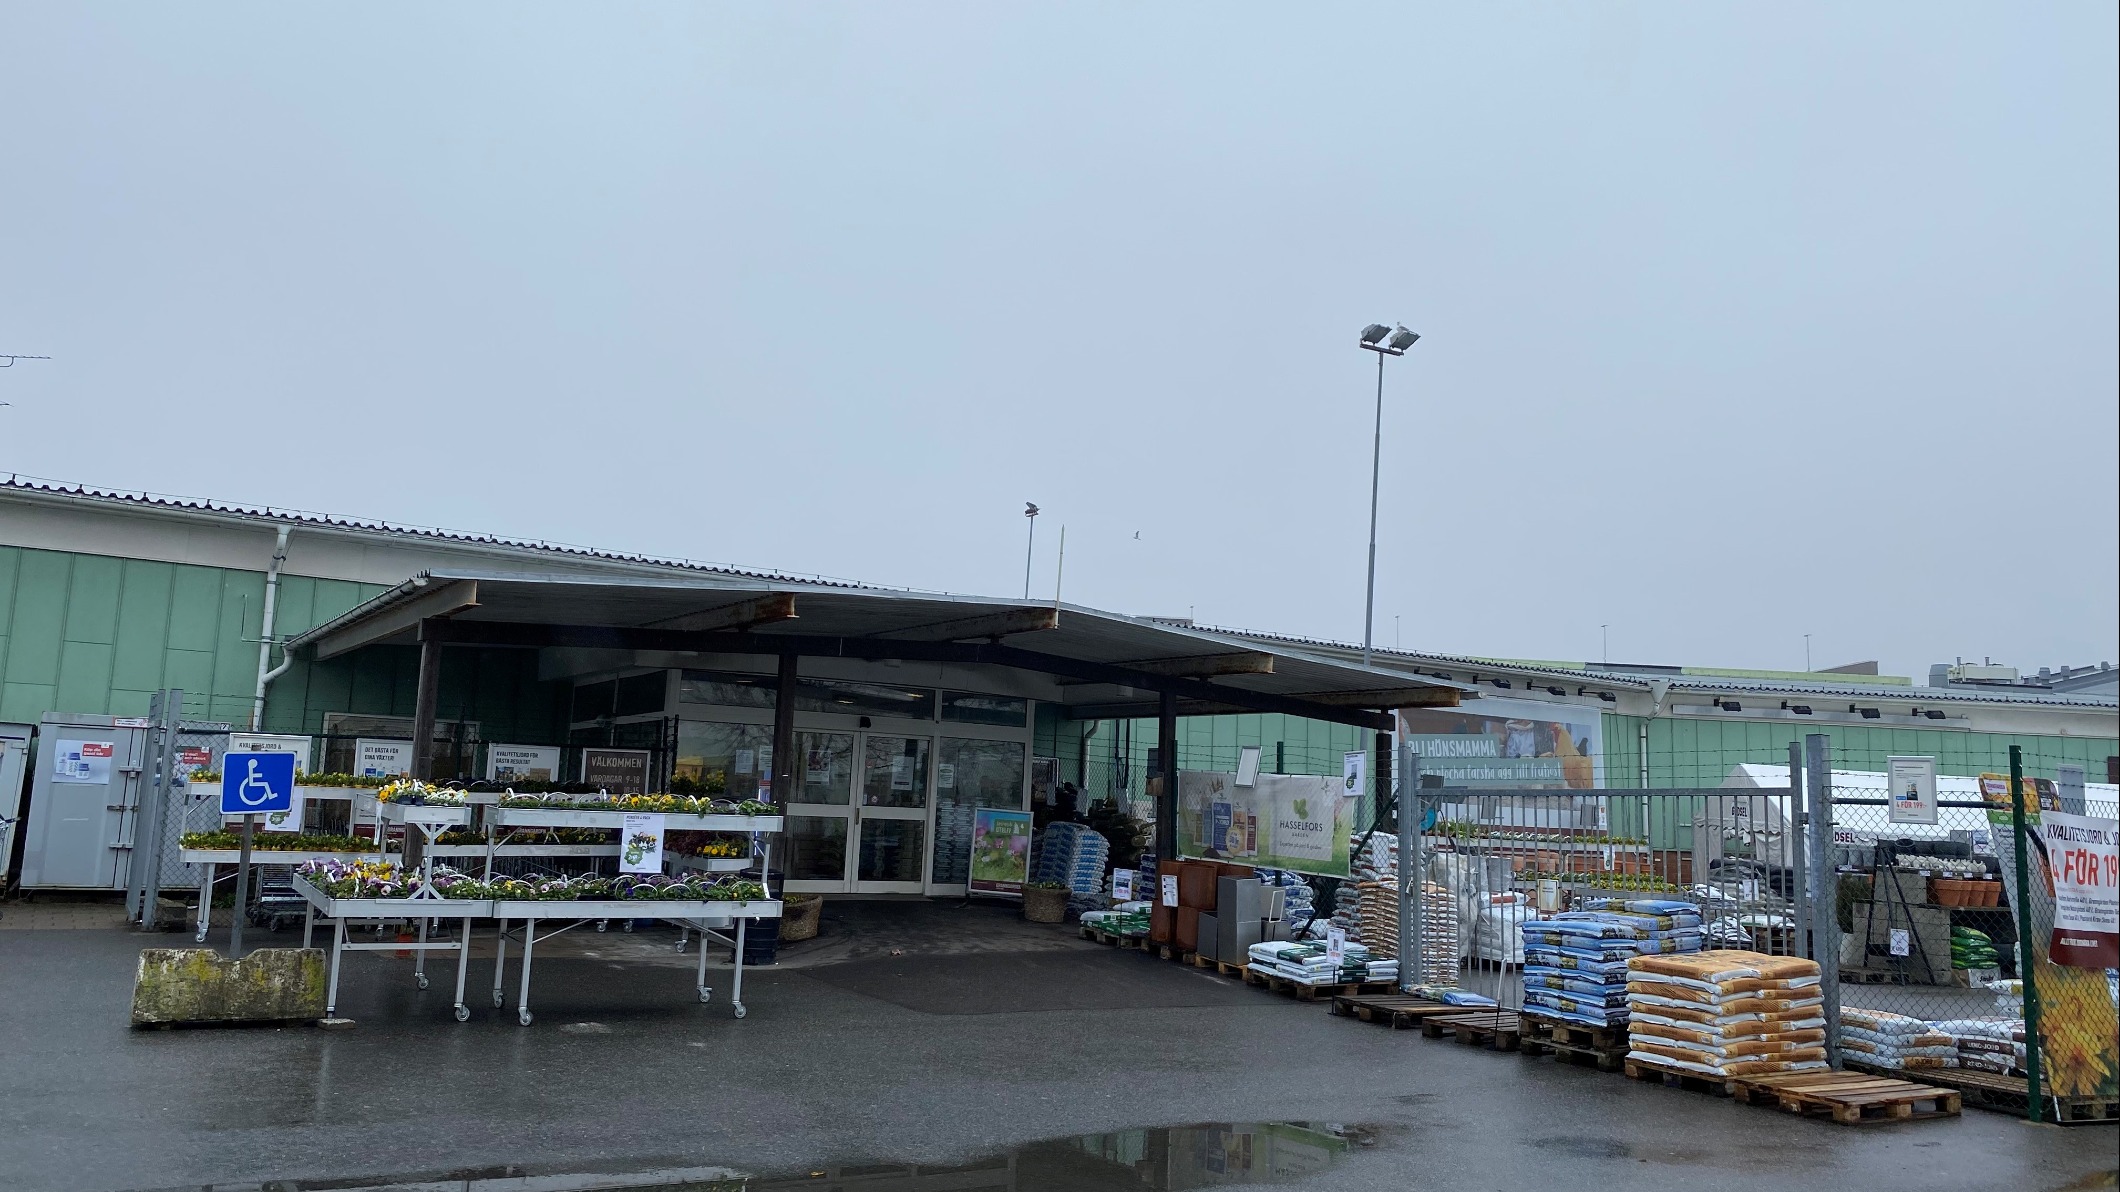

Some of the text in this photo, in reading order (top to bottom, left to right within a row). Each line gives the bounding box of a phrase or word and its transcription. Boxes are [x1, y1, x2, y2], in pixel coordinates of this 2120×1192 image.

[1427, 738, 1496, 757] HÖNSMAMMA
[591, 755, 642, 768] VÄLKOMMEN
[1516, 763, 1528, 778] till
[1530, 762, 1561, 778] frukost
[590, 774, 623, 784] VARDAGAR
[1900, 800, 1913, 809] FÖR
[1279, 820, 1323, 832] HASSELFORS
[2046, 824, 2103, 845] KVALITETSJORD
[2104, 830, 2112, 846] &
[2064, 848, 2099, 886] FÖR
[2104, 854, 2119, 887] 19
